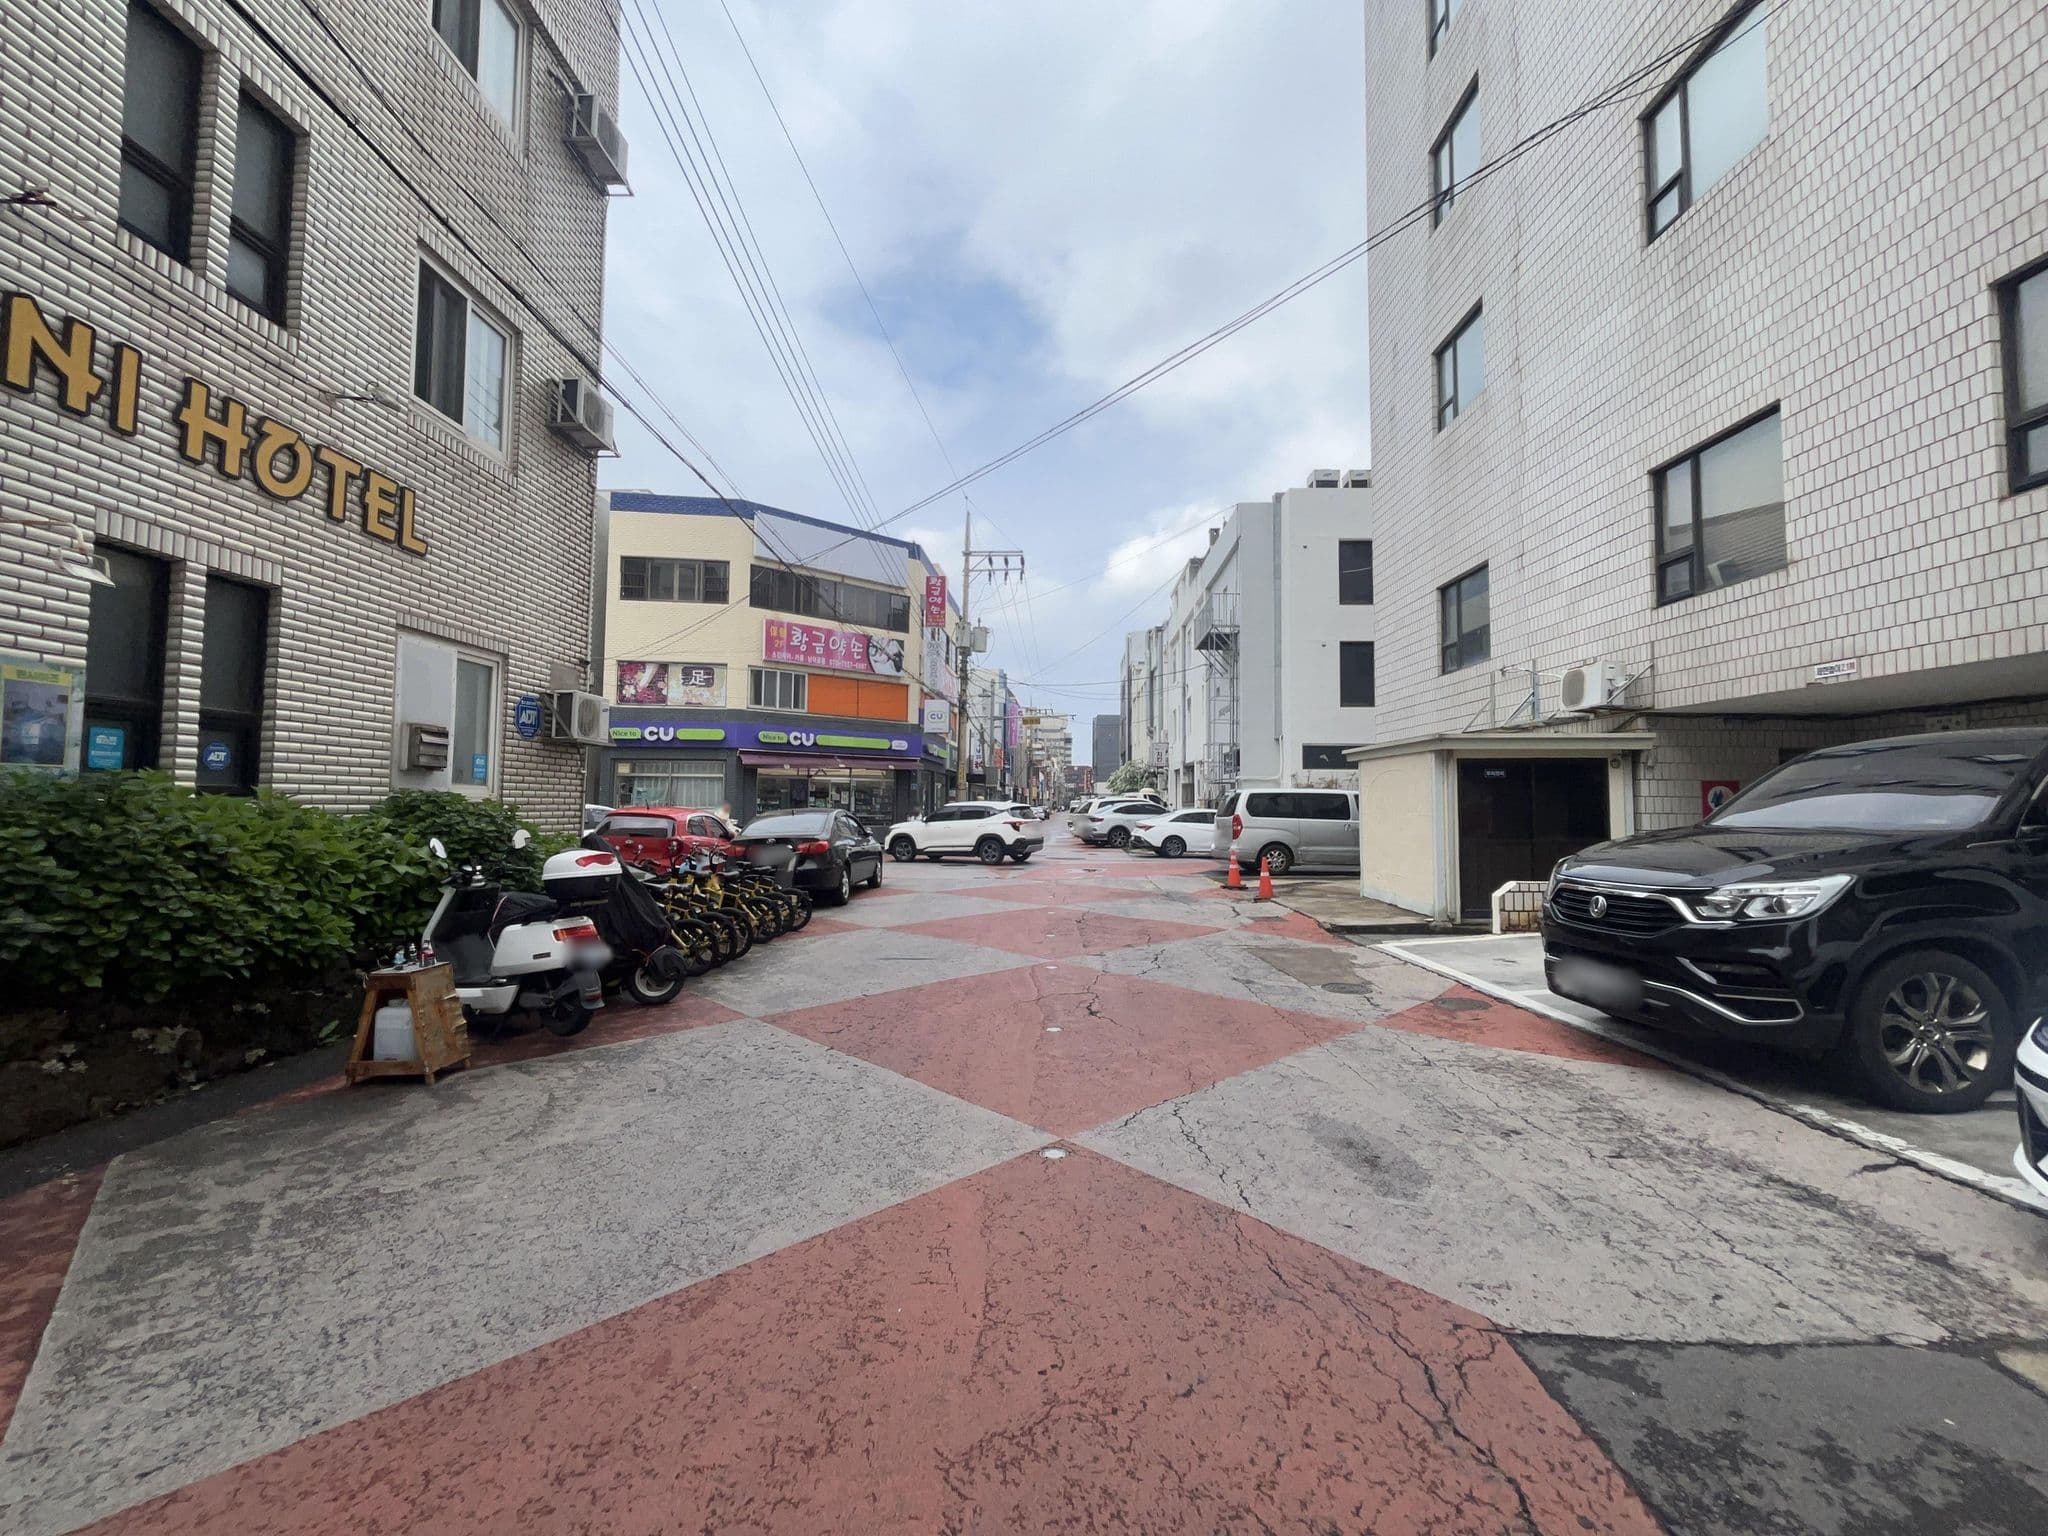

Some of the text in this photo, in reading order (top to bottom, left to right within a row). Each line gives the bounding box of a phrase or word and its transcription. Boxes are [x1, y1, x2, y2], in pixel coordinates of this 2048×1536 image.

[2, 291, 428, 556] NI HOTEL
[790, 626, 863, 660] 황금약손
[519, 709, 537, 725] ADT
[930, 712, 943, 720] CU
[612, 730, 629, 738] Nice
[644, 726, 674, 742] CU
[789, 731, 815, 748] CU
[207, 751, 227, 762] ADT
